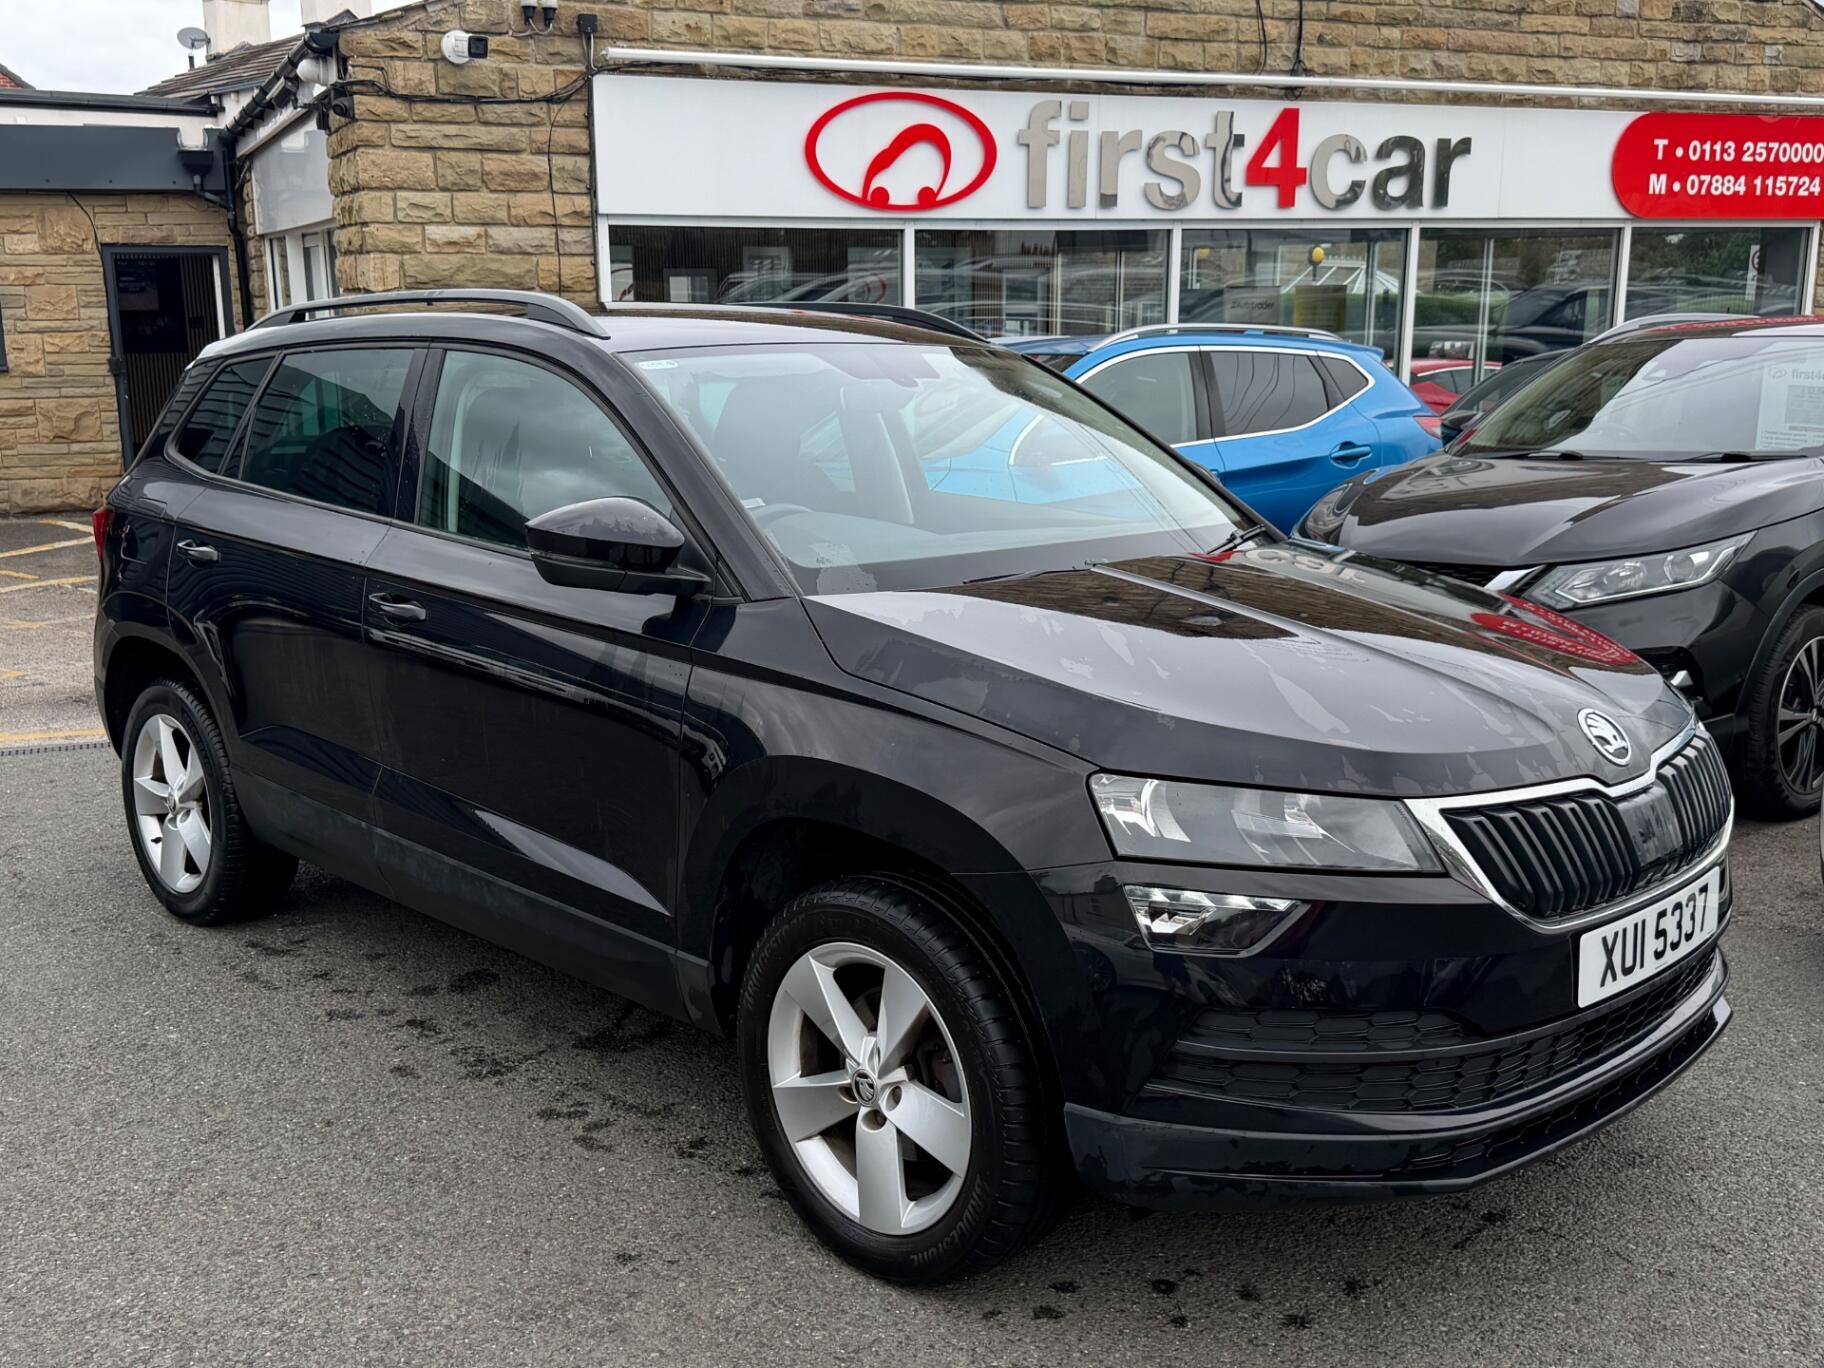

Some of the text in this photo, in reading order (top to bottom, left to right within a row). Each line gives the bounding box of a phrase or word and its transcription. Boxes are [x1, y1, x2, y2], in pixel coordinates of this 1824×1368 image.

[1018, 100, 1472, 211] first4car
[1653, 138, 1824, 164] T 0113 2570000
[1648, 173, 1821, 197] M 07884 115724
[1792, 368, 1824, 381] first4
[1600, 882, 1709, 988] XUI 5337
